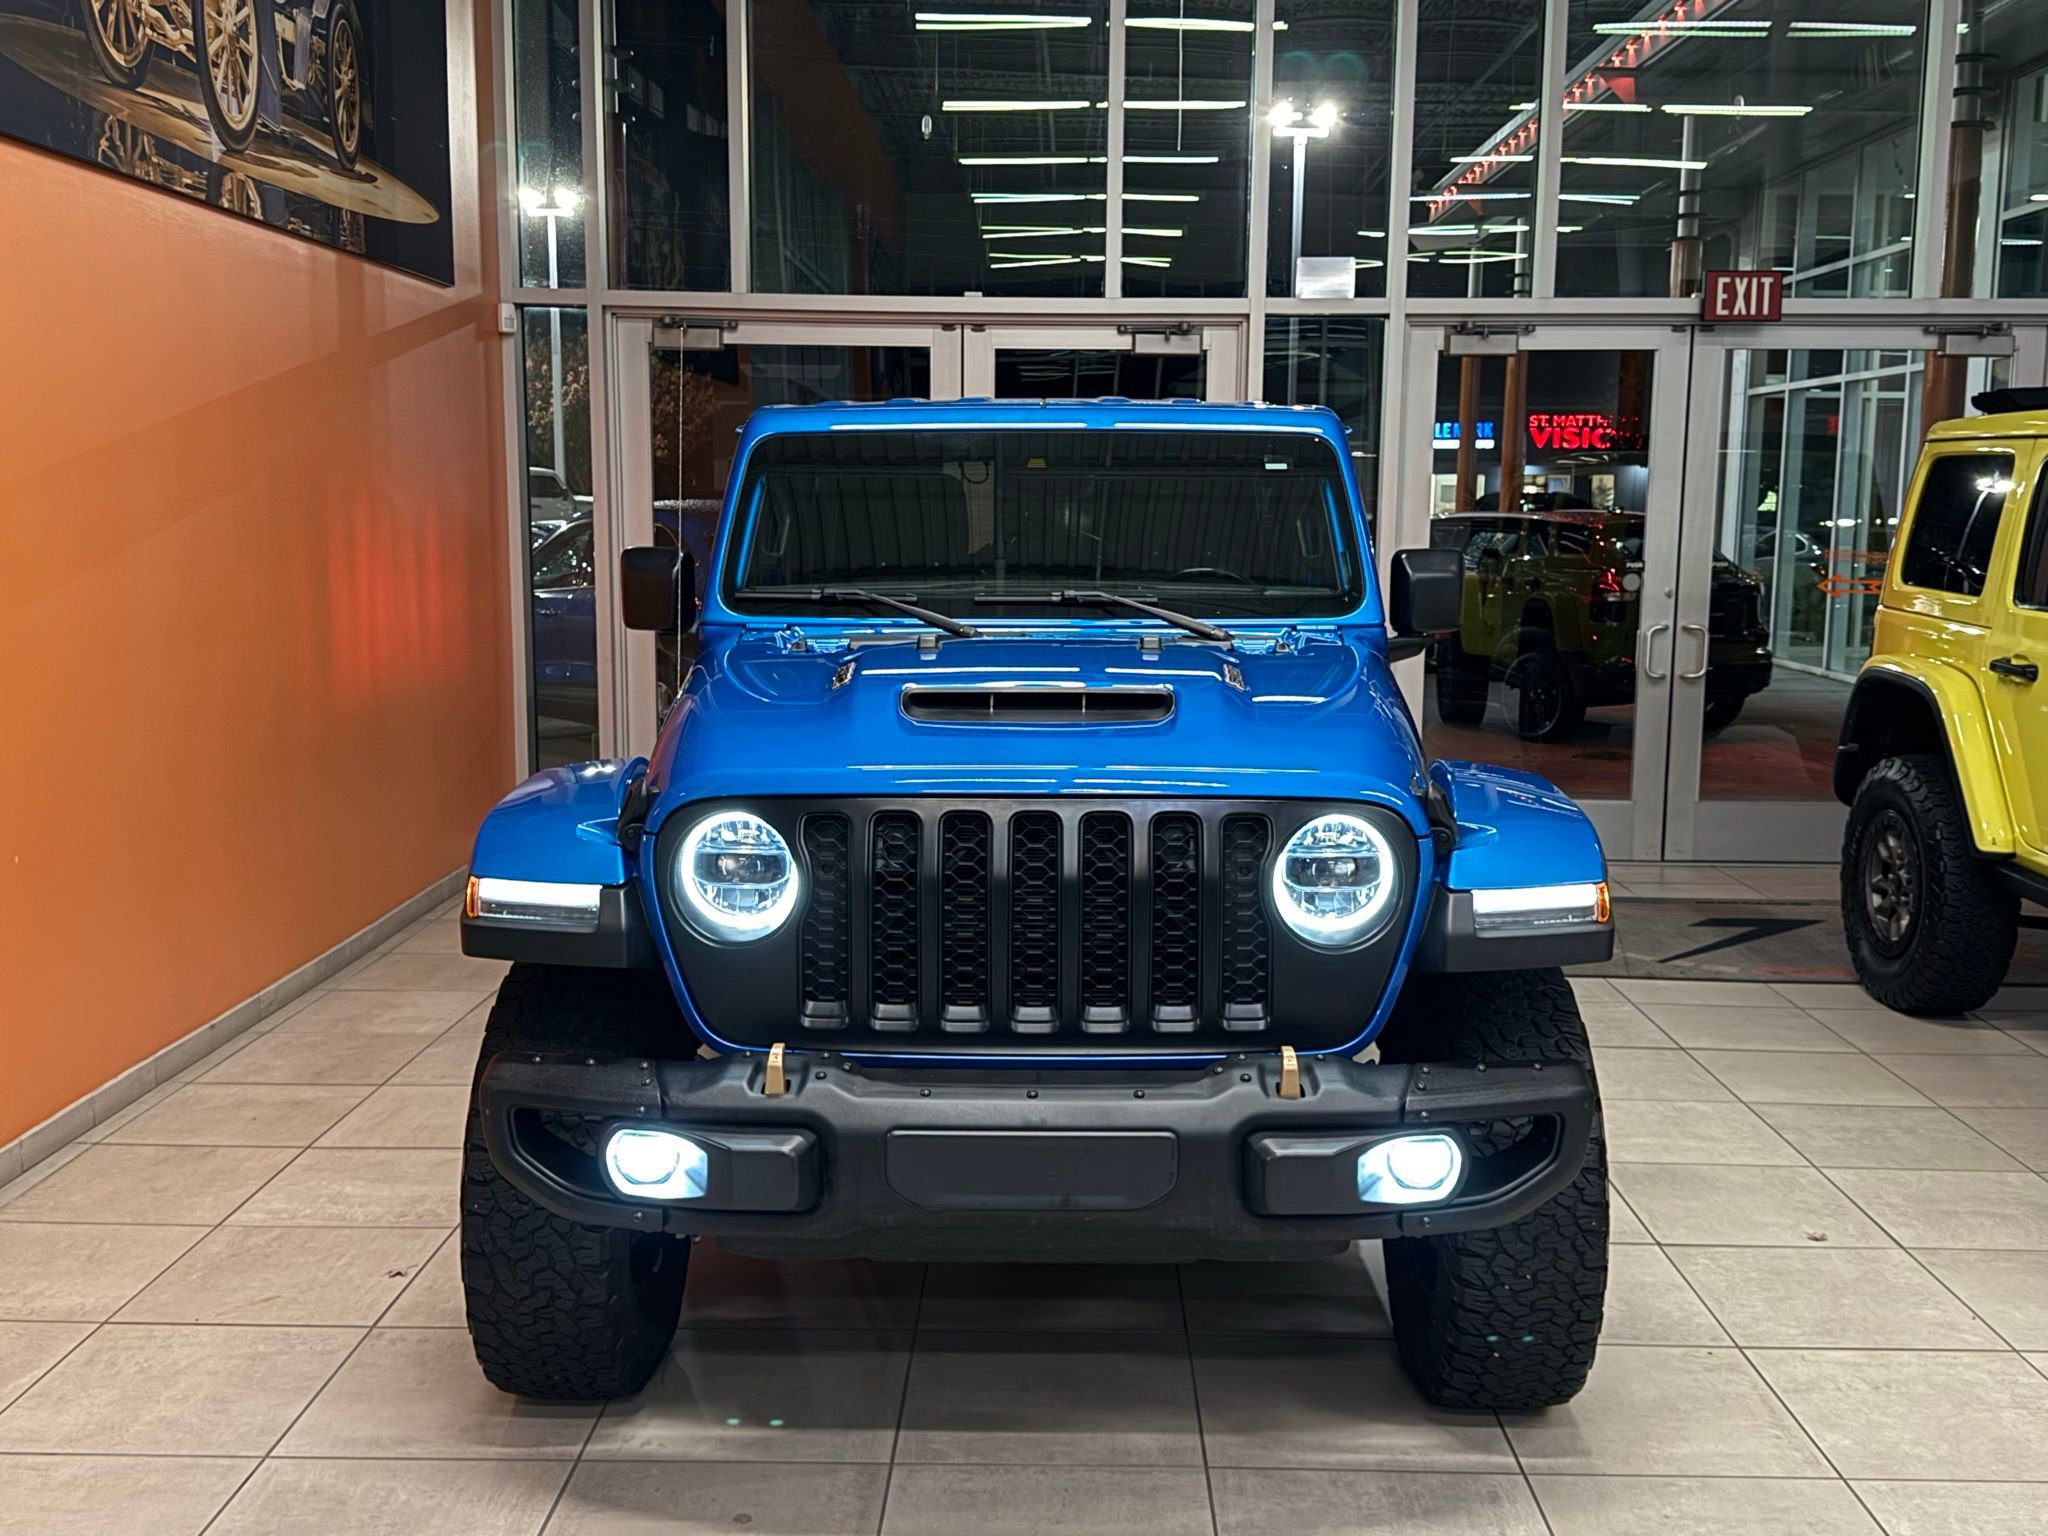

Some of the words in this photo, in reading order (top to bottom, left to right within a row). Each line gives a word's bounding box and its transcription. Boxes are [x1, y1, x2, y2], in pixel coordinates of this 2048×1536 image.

[1716, 277, 1774, 315] EXIT
[1529, 415, 1550, 427] ST.
[1529, 427, 1641, 449] VISIO
